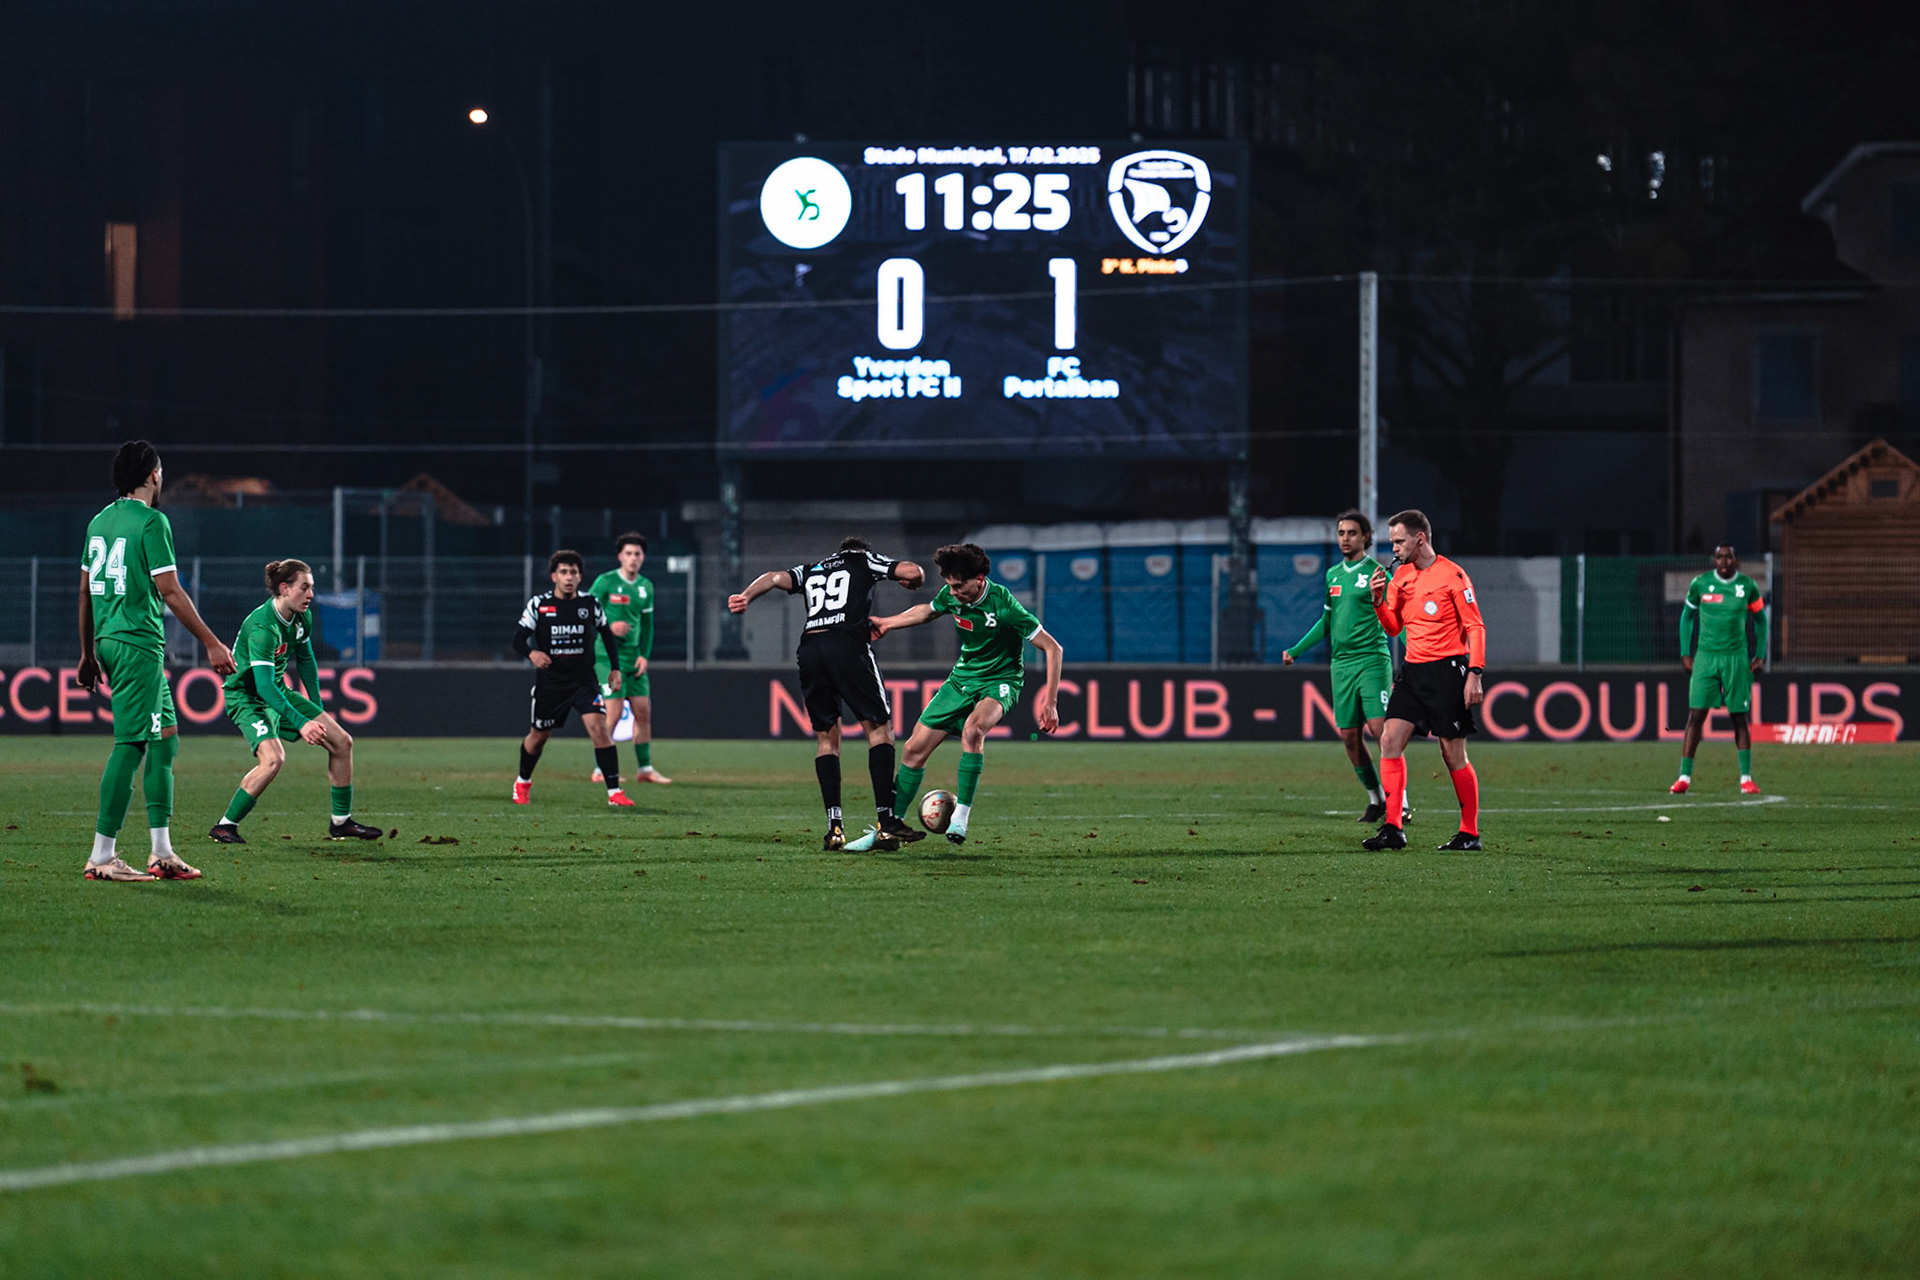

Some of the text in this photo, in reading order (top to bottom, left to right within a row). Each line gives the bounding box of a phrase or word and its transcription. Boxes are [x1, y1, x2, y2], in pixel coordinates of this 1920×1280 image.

[863, 146, 917, 165] Stade
[917, 146, 1008, 167] Municipal,
[896, 172, 1071, 230] 11:25
[877, 258, 925, 350] 0
[1048, 258, 1077, 350] 1
[852, 355, 951, 378] Yverdon
[1046, 356, 1082, 378] FC
[836, 375, 905, 402] Sport
[906, 375, 940, 399] FC
[1003, 375, 1120, 399] Portalban
[88, 536, 127, 595] 24
[805, 569, 851, 617] 69
[1033, 678, 1232, 738] CLUB
[1380, 690, 1389, 704] 6
